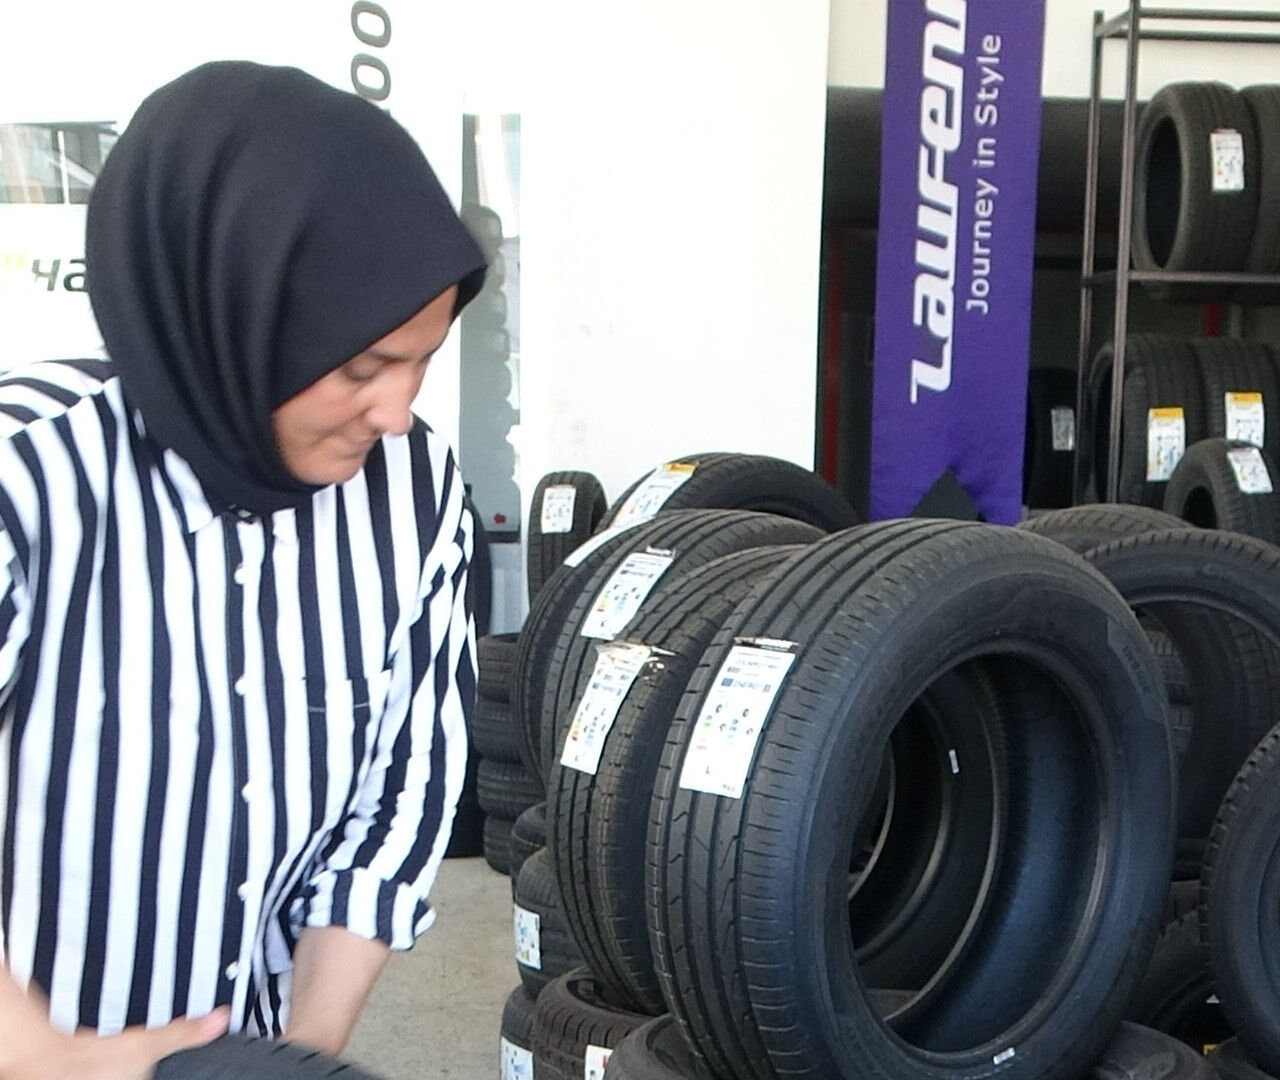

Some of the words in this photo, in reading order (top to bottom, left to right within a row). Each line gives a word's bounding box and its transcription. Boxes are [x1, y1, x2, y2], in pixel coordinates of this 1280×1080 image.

[974, 33, 1005, 125] Style
[910, 0, 969, 405] Laufen
[973, 136, 997, 169] in
[965, 179, 999, 316] Journey
